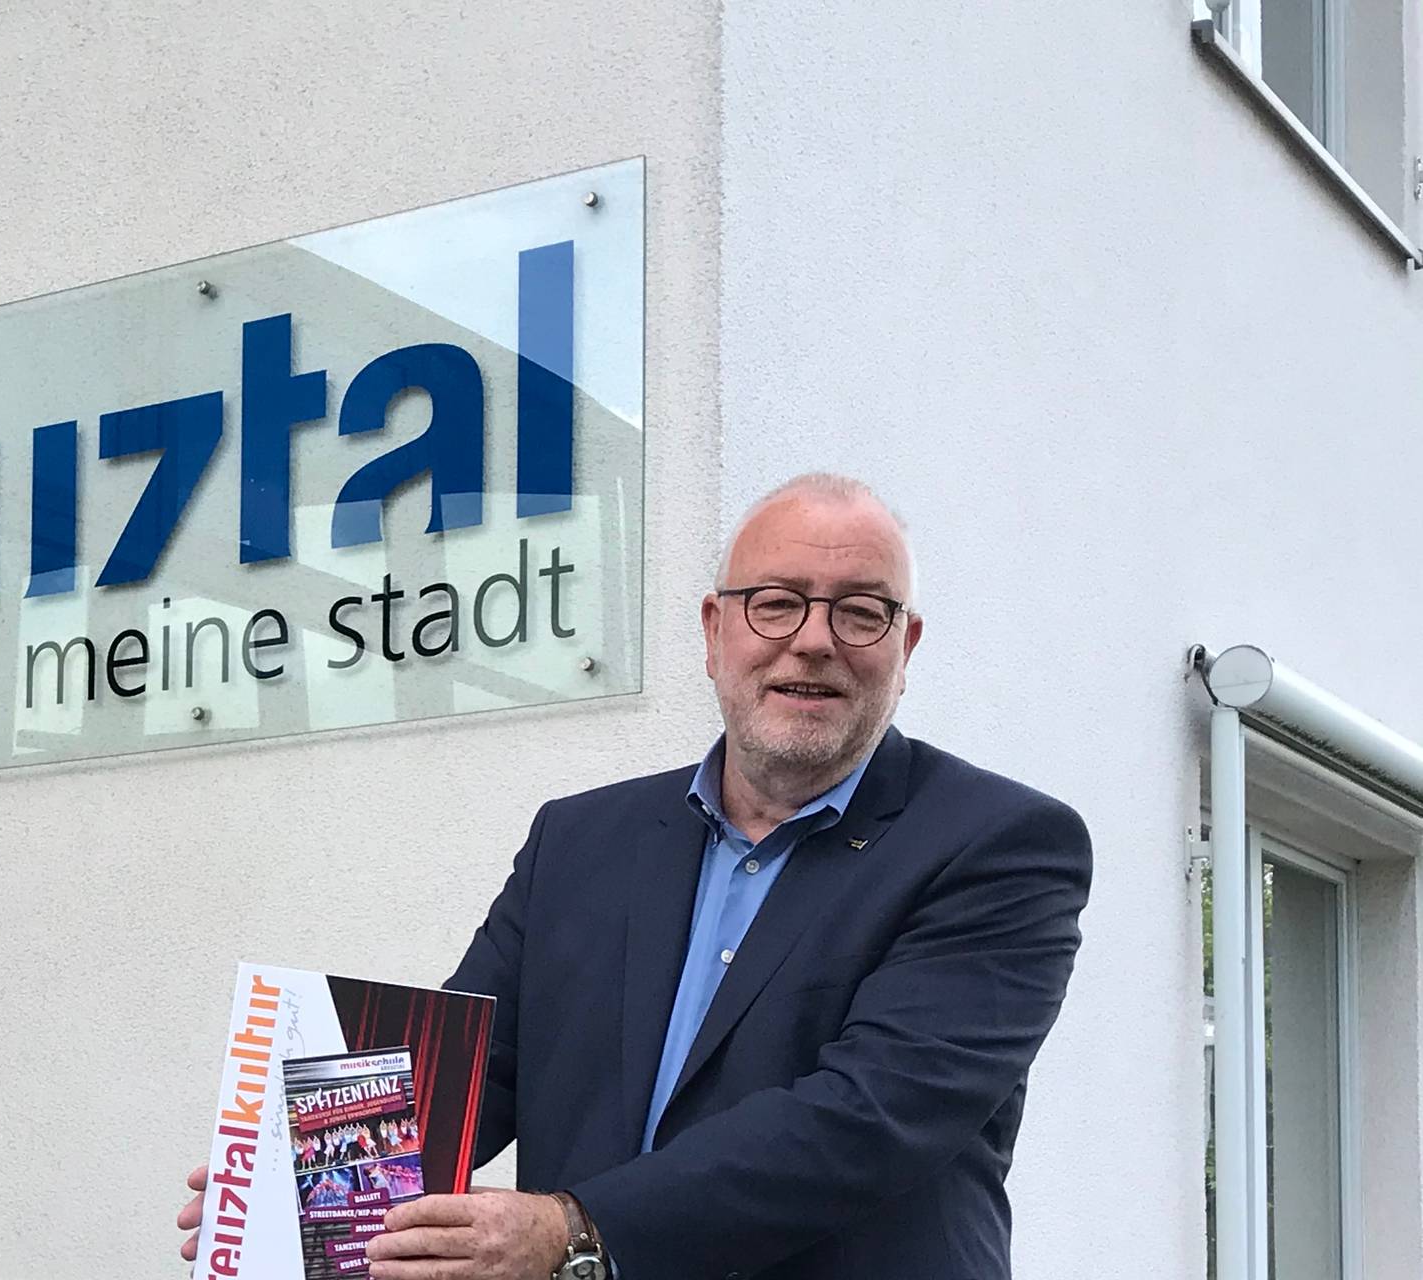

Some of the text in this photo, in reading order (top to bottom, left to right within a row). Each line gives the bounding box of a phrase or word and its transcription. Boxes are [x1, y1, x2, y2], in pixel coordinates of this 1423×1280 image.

[25, 538, 576, 709] meine stadt
[340, 1056, 405, 1070] musikschule
[295, 1076, 401, 1114] SPITZENTANZ
[354, 1192, 381, 1203] BALLETT
[355, 1224, 385, 1233] MODERN
[333, 1241, 369, 1252] TANZTHEA
[340, 1258, 362, 1269] KURSE
